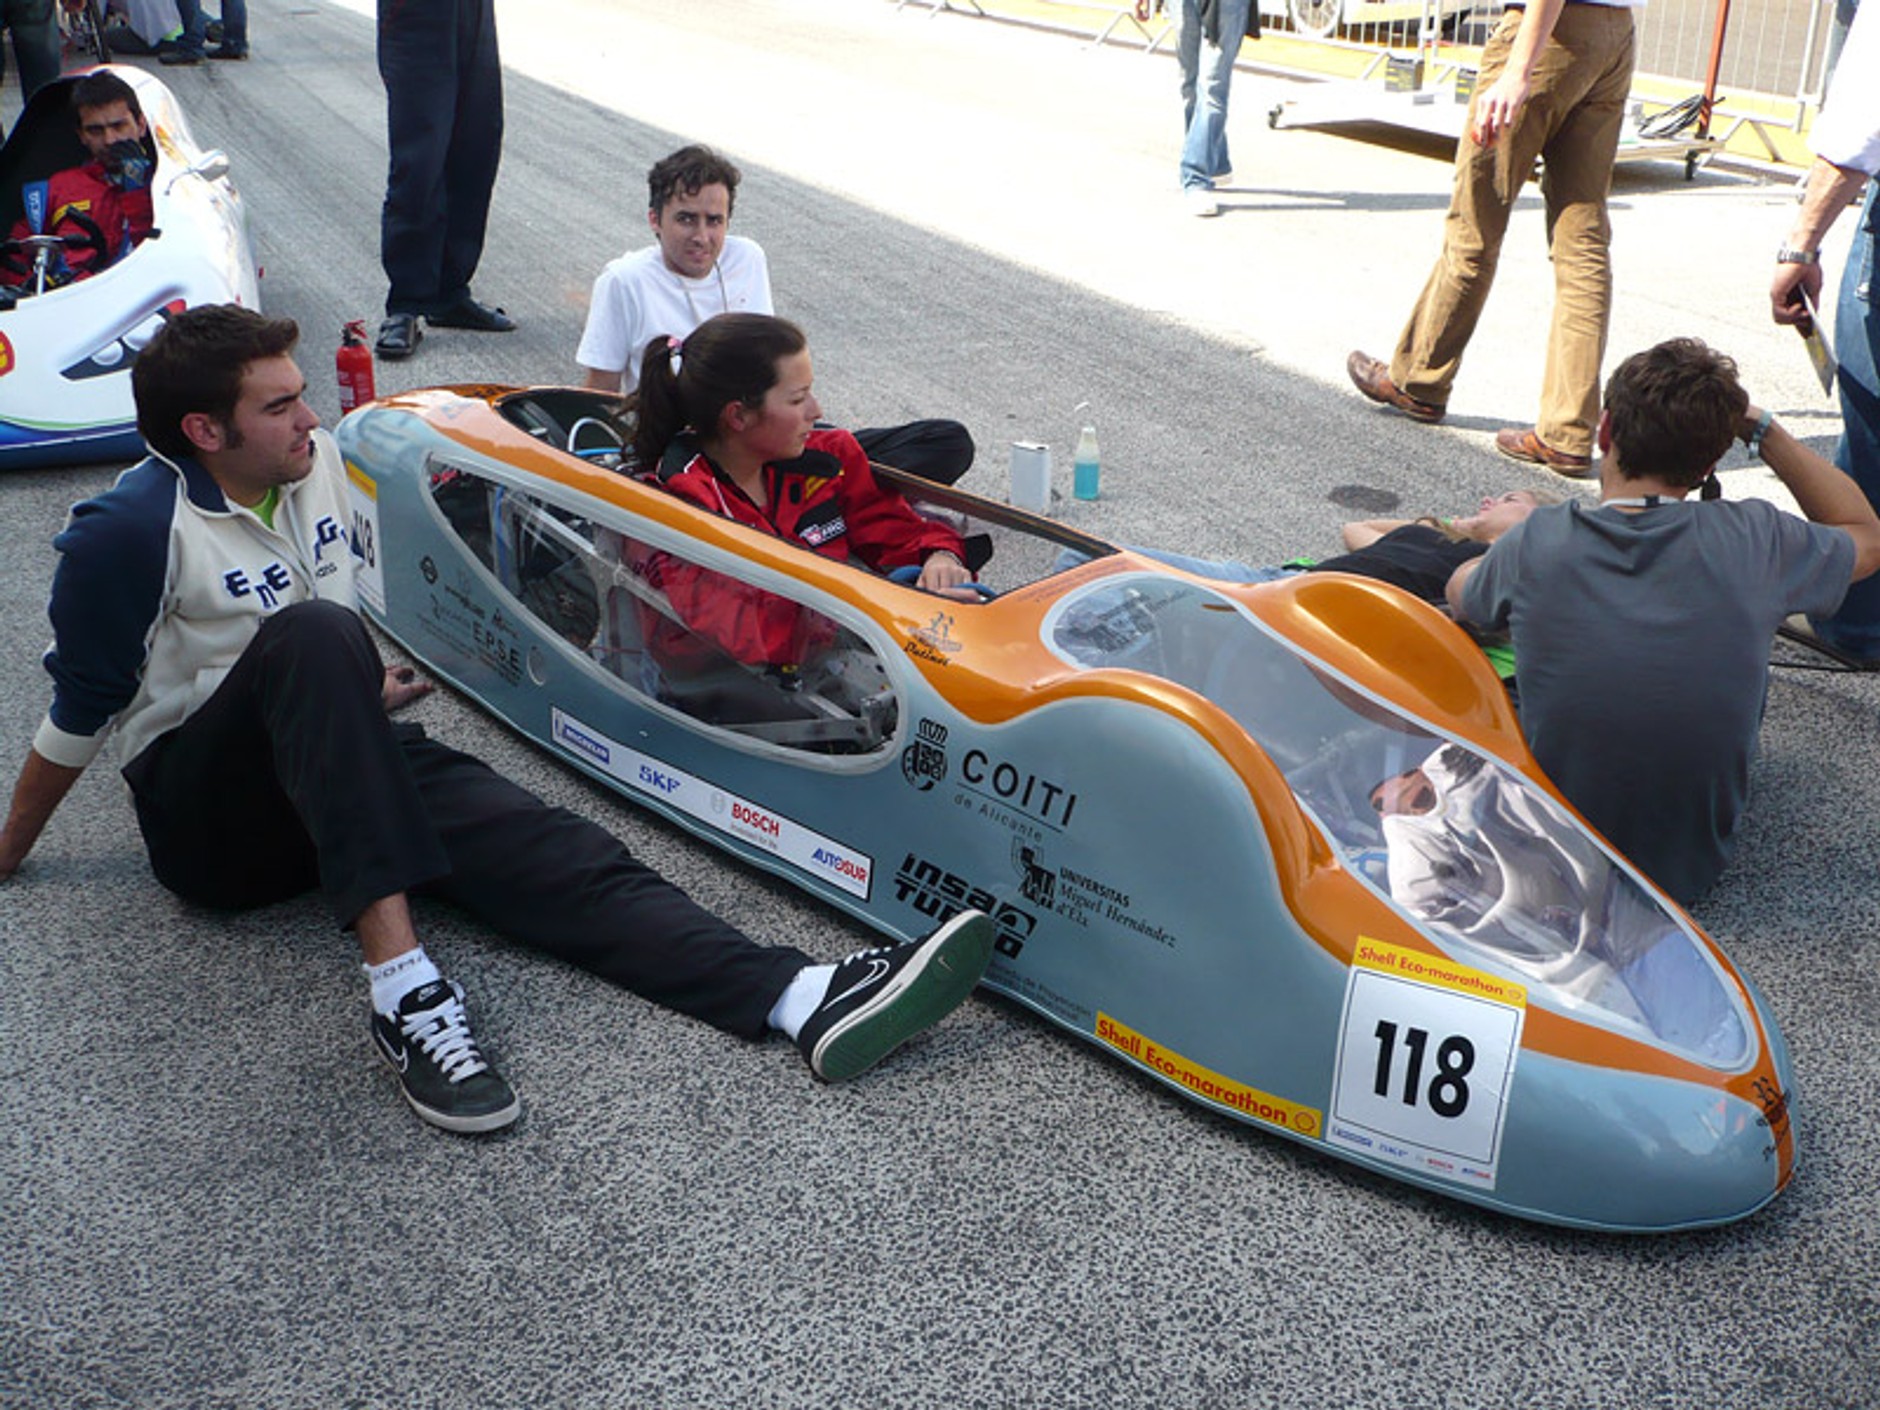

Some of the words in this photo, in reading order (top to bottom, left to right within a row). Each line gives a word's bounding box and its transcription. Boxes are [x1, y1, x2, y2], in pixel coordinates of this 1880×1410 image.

[639, 765, 681, 793] SKF
[962, 749, 1077, 826] COITI
[731, 802, 780, 838] BOSCH
[954, 793, 972, 809] de
[979, 803, 1043, 842] Alicante
[811, 848, 867, 883] AUTOSUR
[1060, 867, 1130, 908] UNIVERSITAS
[1061, 883, 1103, 913] Miguel
[1106, 903, 1176, 948] Hernández
[1358, 946, 1396, 966] Shell
[1400, 957, 1504, 996] Eco-marathon
[1098, 1019, 1141, 1054] Shell
[1146, 1047, 1288, 1125] Eco-marathon
[1374, 1019, 1475, 1118] 118
